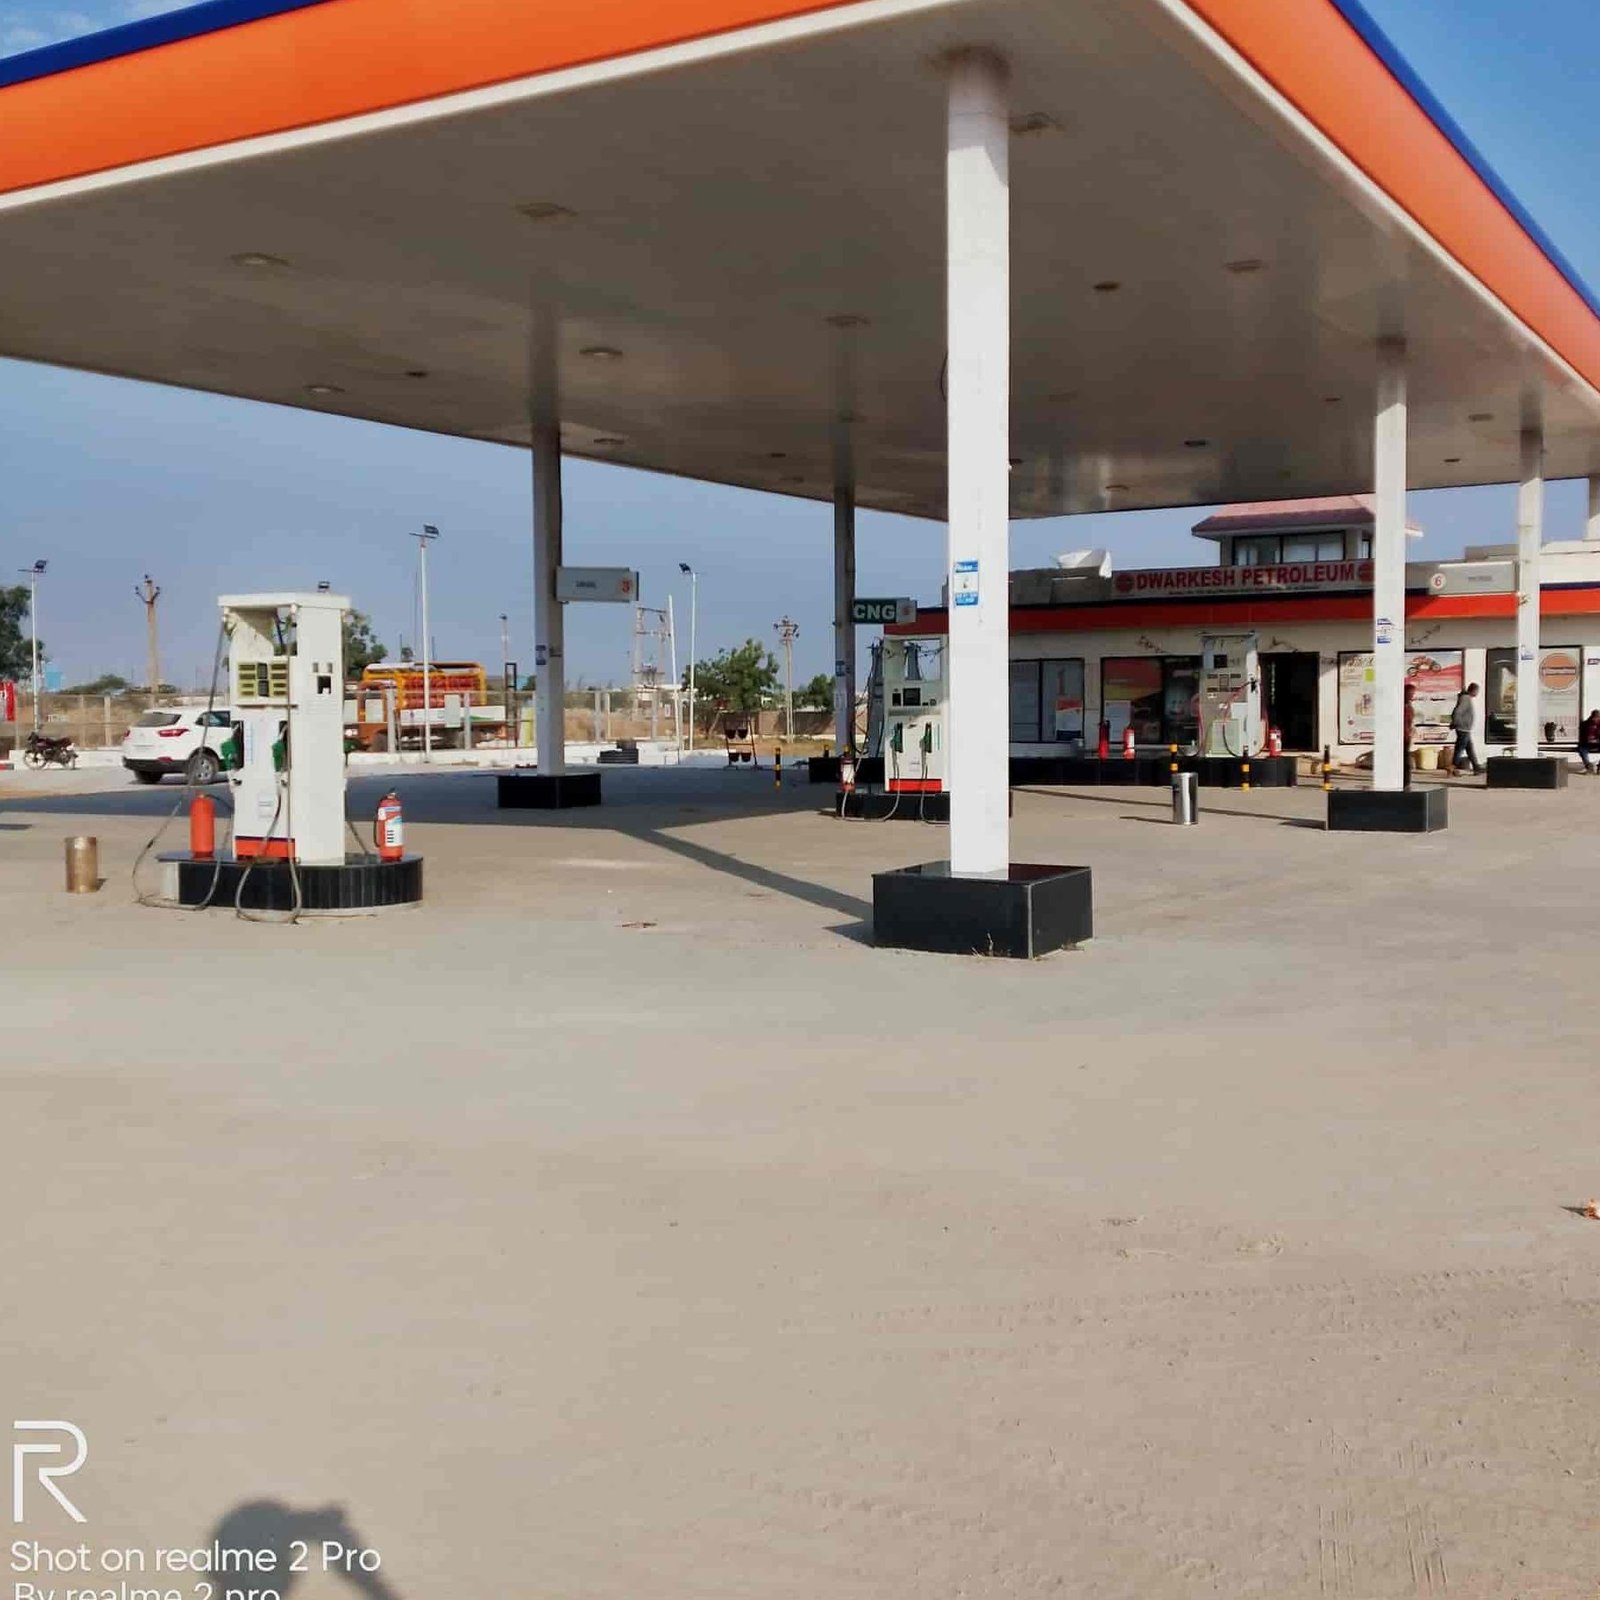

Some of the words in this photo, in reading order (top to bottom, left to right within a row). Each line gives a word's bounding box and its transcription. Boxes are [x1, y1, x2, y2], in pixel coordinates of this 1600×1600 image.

[1136, 569, 1236, 590] DWARKESH
[1241, 563, 1355, 586] PETROLEUM
[1434, 575, 1442, 587] 6
[853, 604, 896, 620] CNG
